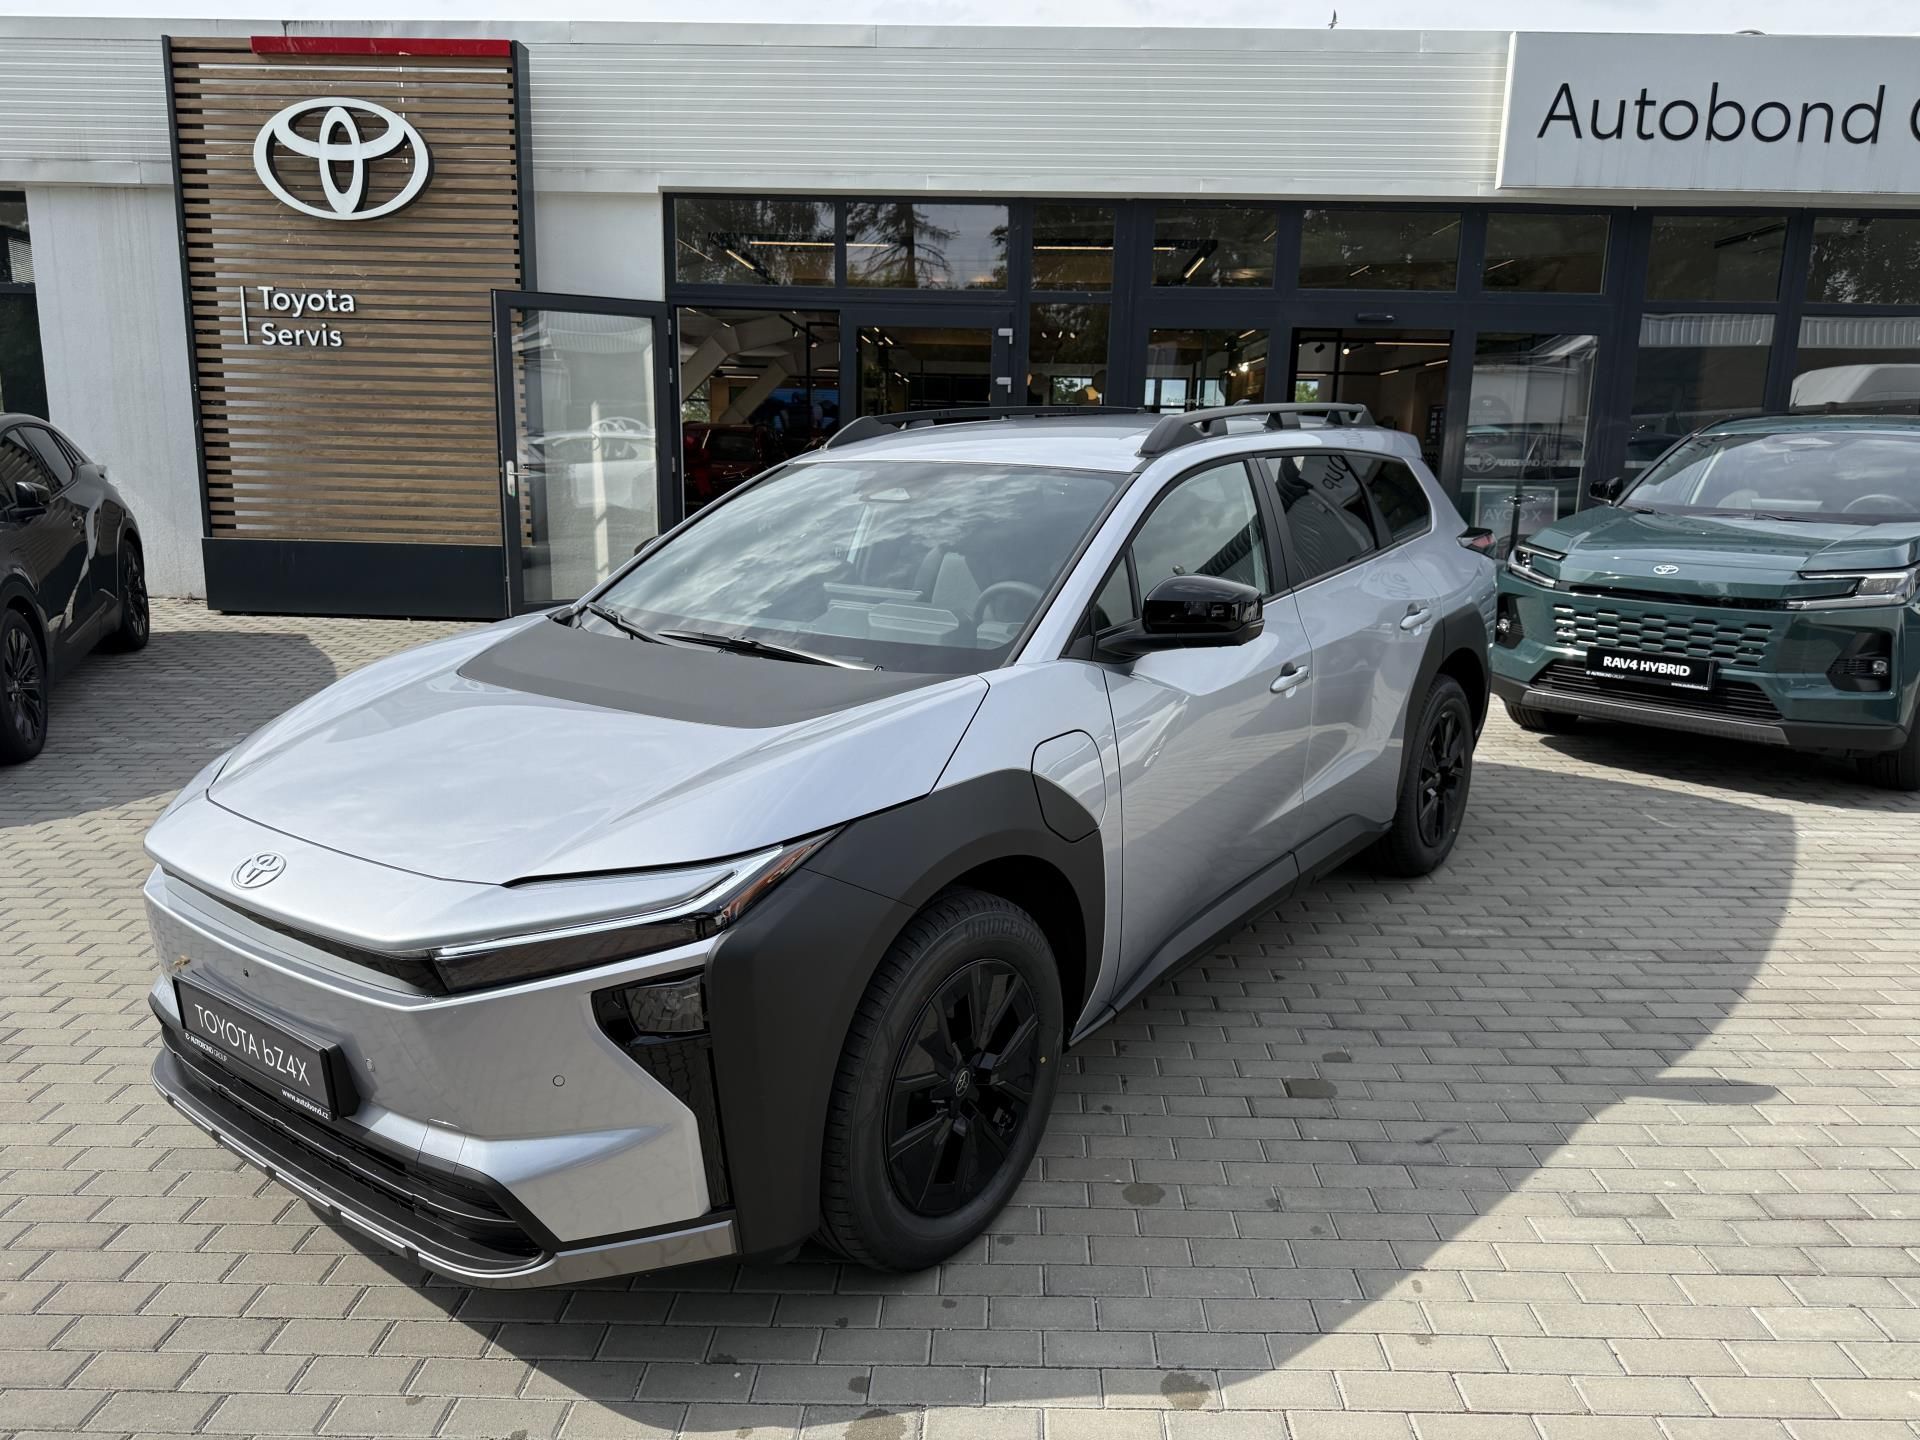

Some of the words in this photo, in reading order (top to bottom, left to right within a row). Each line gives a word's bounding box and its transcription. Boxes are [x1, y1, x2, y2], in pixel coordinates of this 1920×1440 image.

[1537, 82, 1885, 144] Autobond
[257, 286, 355, 319] Toyota
[261, 322, 343, 347] Servis
[1603, 655, 1638, 670] RAV4
[1639, 660, 1691, 677] HYBRID
[194, 1003, 260, 1060] TOYOTA
[262, 1038, 310, 1087] bZ4X
